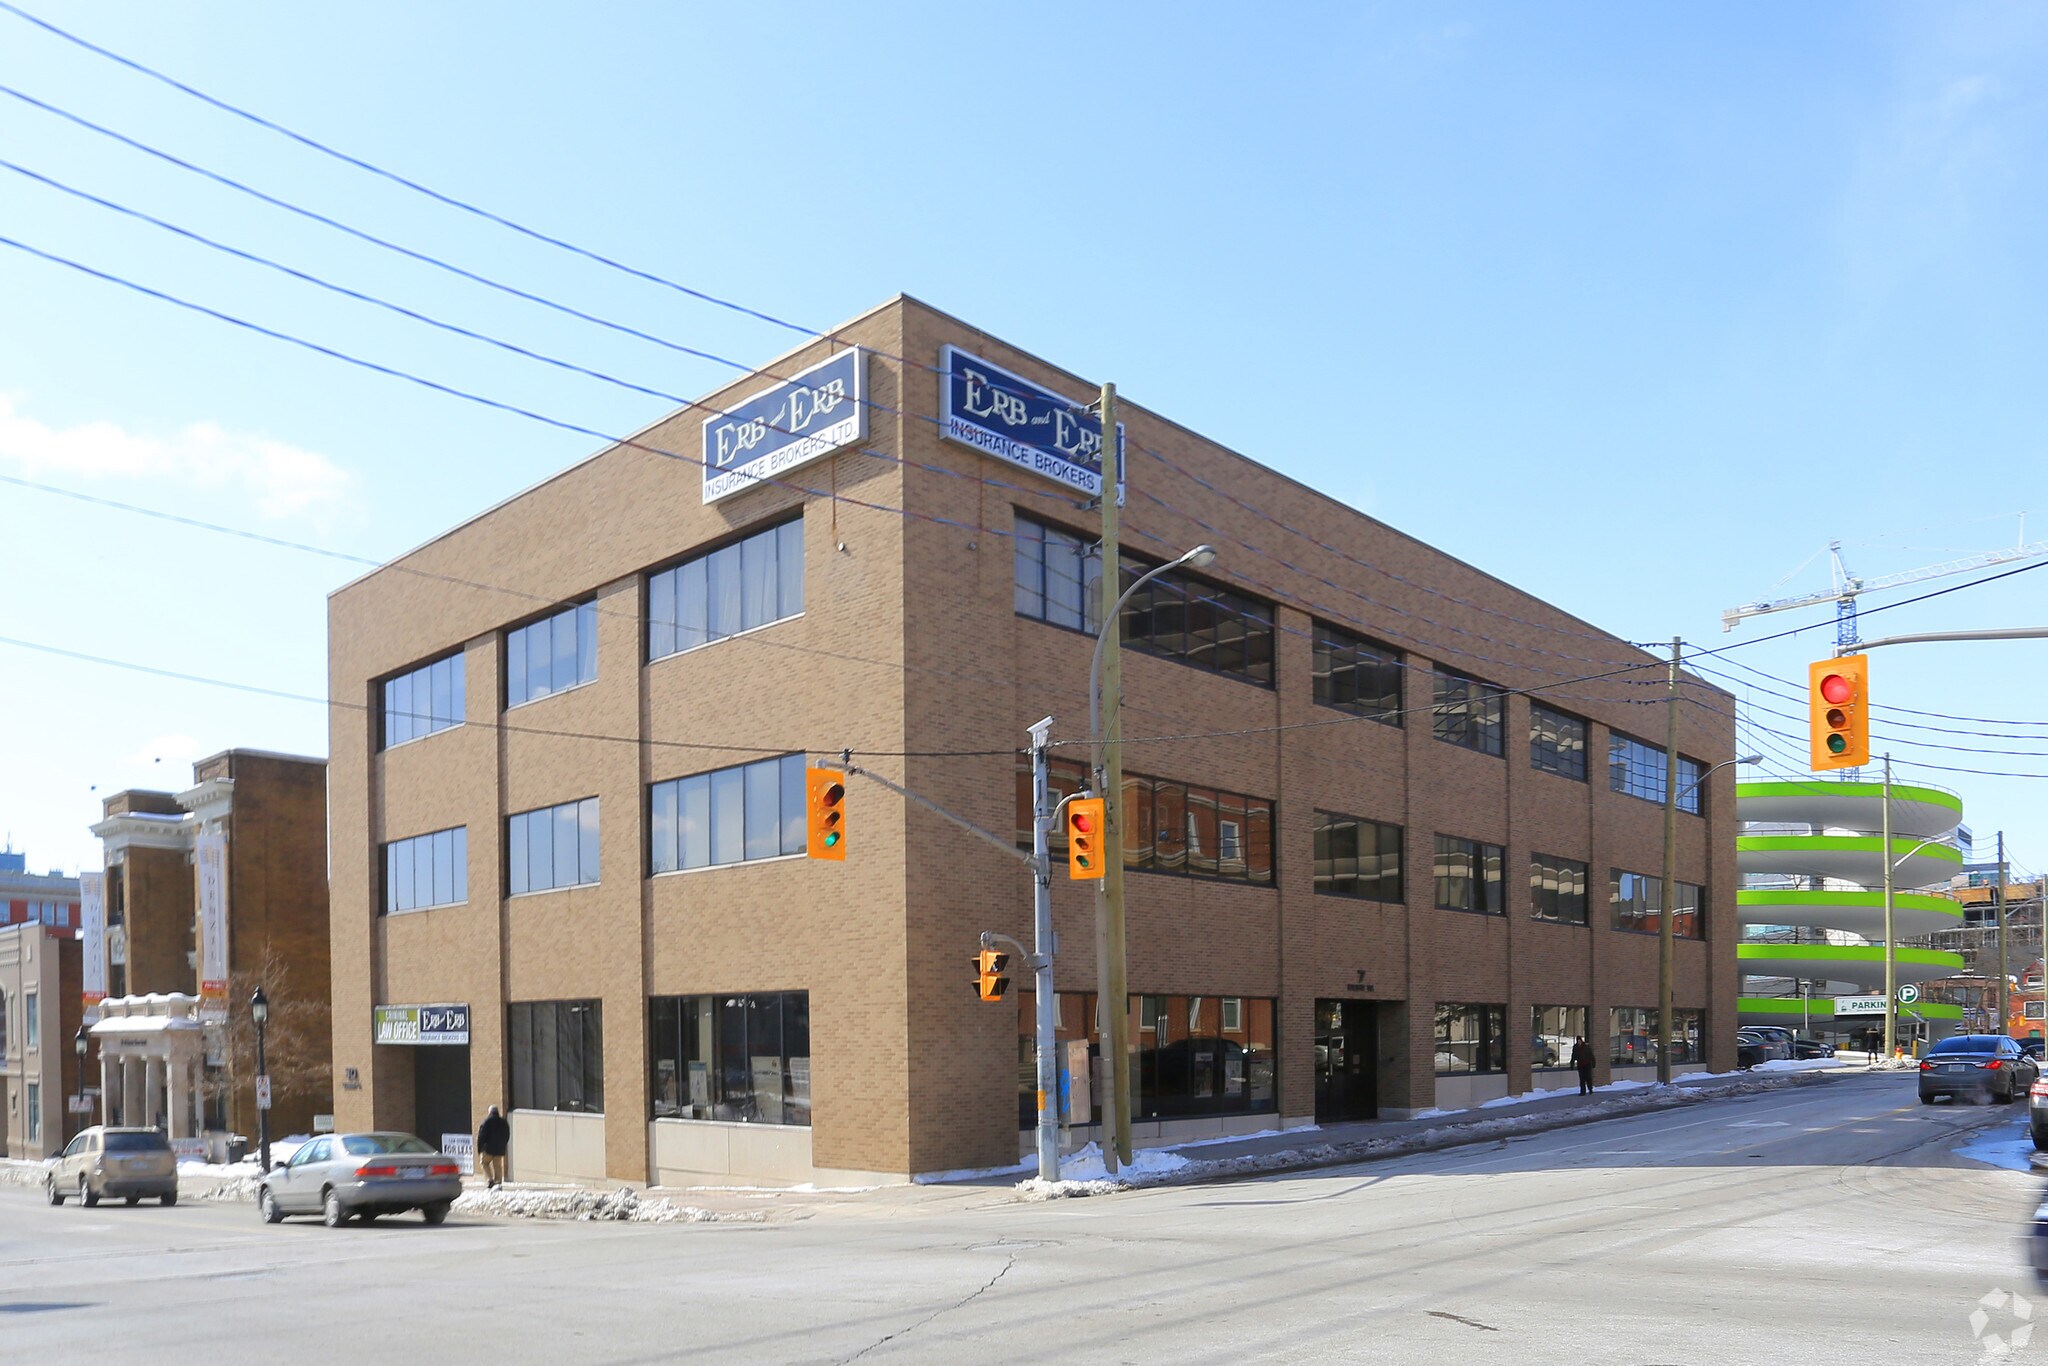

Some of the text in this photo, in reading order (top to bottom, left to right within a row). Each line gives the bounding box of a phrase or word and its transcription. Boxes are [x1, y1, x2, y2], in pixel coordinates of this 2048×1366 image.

[1031, 411, 1050, 426] and
[950, 419, 1029, 464] INSURANCE
[1035, 453, 1095, 490] BROKERS
[704, 459, 766, 499] INSURANCE
[770, 433, 827, 471] BROKERS
[1357, 969, 1366, 983] 7
[1851, 1001, 1887, 1010] PARKIN
[377, 1021, 418, 1040] LAW OFFICE
